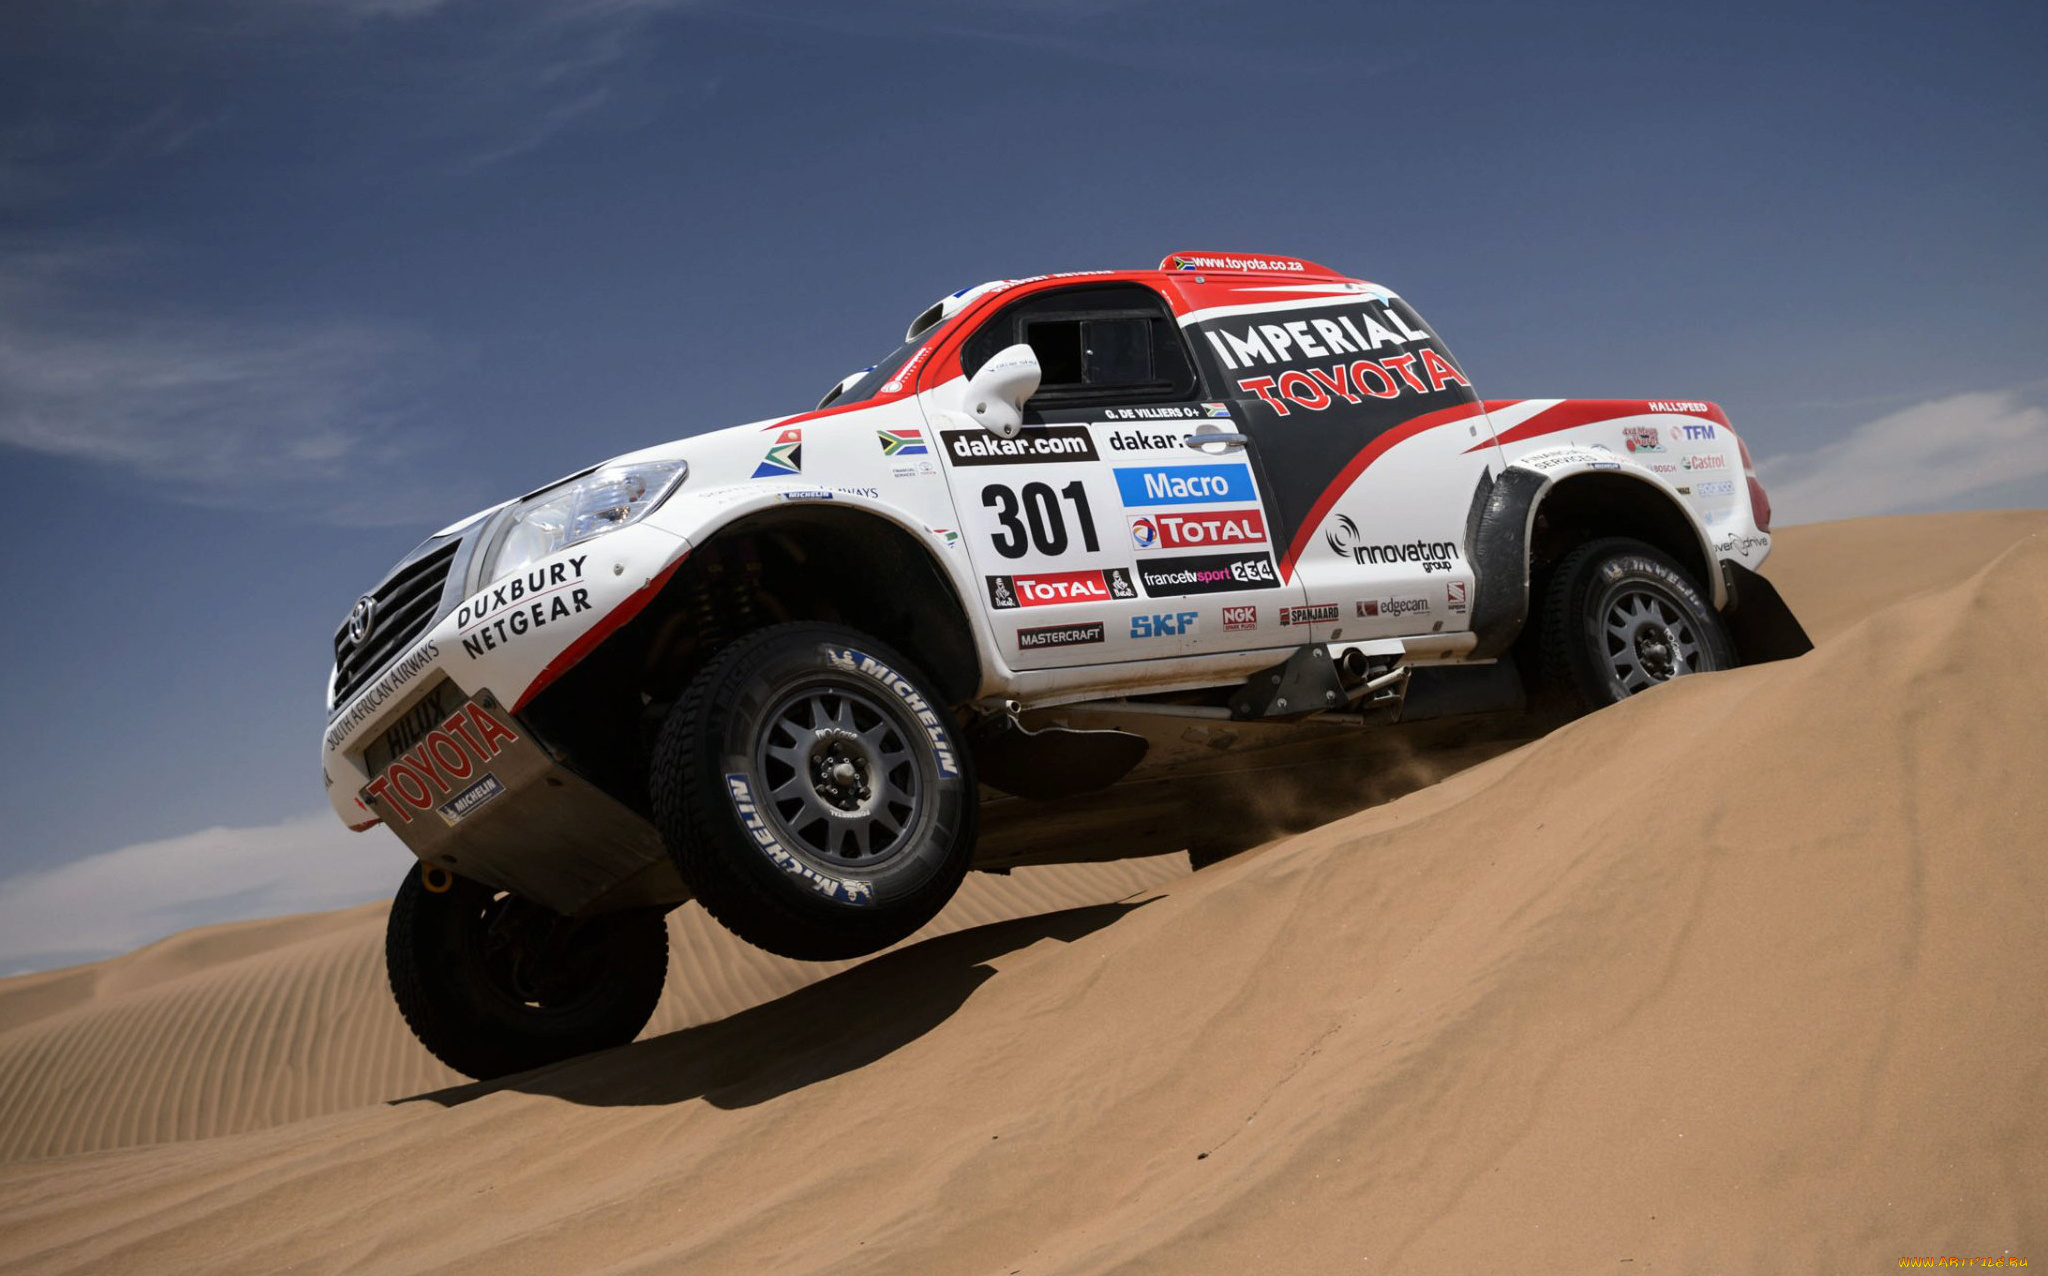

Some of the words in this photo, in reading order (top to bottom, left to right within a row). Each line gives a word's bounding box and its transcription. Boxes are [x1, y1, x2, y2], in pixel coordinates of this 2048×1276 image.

[1193, 257, 1304, 272] www.toyota.co.za
[1205, 309, 1431, 370] IMPERIAL
[1238, 348, 1471, 416] TOYOTA
[1105, 409, 1119, 419] G.
[1119, 408, 1135, 419] DE
[1136, 407, 1183, 418] VILLIERS
[1648, 402, 1708, 412] HALLSPEED
[1683, 425, 1715, 440] TFM
[953, 434, 1088, 459] dakar.com
[1692, 455, 1724, 470] Castrol
[1143, 472, 1229, 499] Macro
[981, 480, 1101, 560] 301
[1160, 517, 1263, 543] TOTAL
[1353, 539, 1459, 565] innovation
[1144, 566, 1231, 587] francetvsport
[1422, 561, 1452, 573] group
[458, 555, 588, 630] DUXBURY
[1016, 580, 1107, 600] TOTAL
[1223, 607, 1256, 624] NGK
[1292, 606, 1339, 622] SPANJAARD
[1380, 597, 1429, 617] edgecam
[462, 588, 592, 660] NETGEAR
[1021, 628, 1100, 646] MASTERCRAFT
[1131, 611, 1199, 639] SKF
[327, 713, 355, 751] SOUTH
[350, 678, 395, 725] AFRICAN
[390, 639, 440, 690] AIRWAYS
[386, 690, 446, 760] HILUX
[859, 656, 958, 775] MICHELIN
[366, 701, 519, 824] TOYOTA
[454, 778, 497, 812] MICHELIN
[729, 777, 840, 898] MICHELIN
